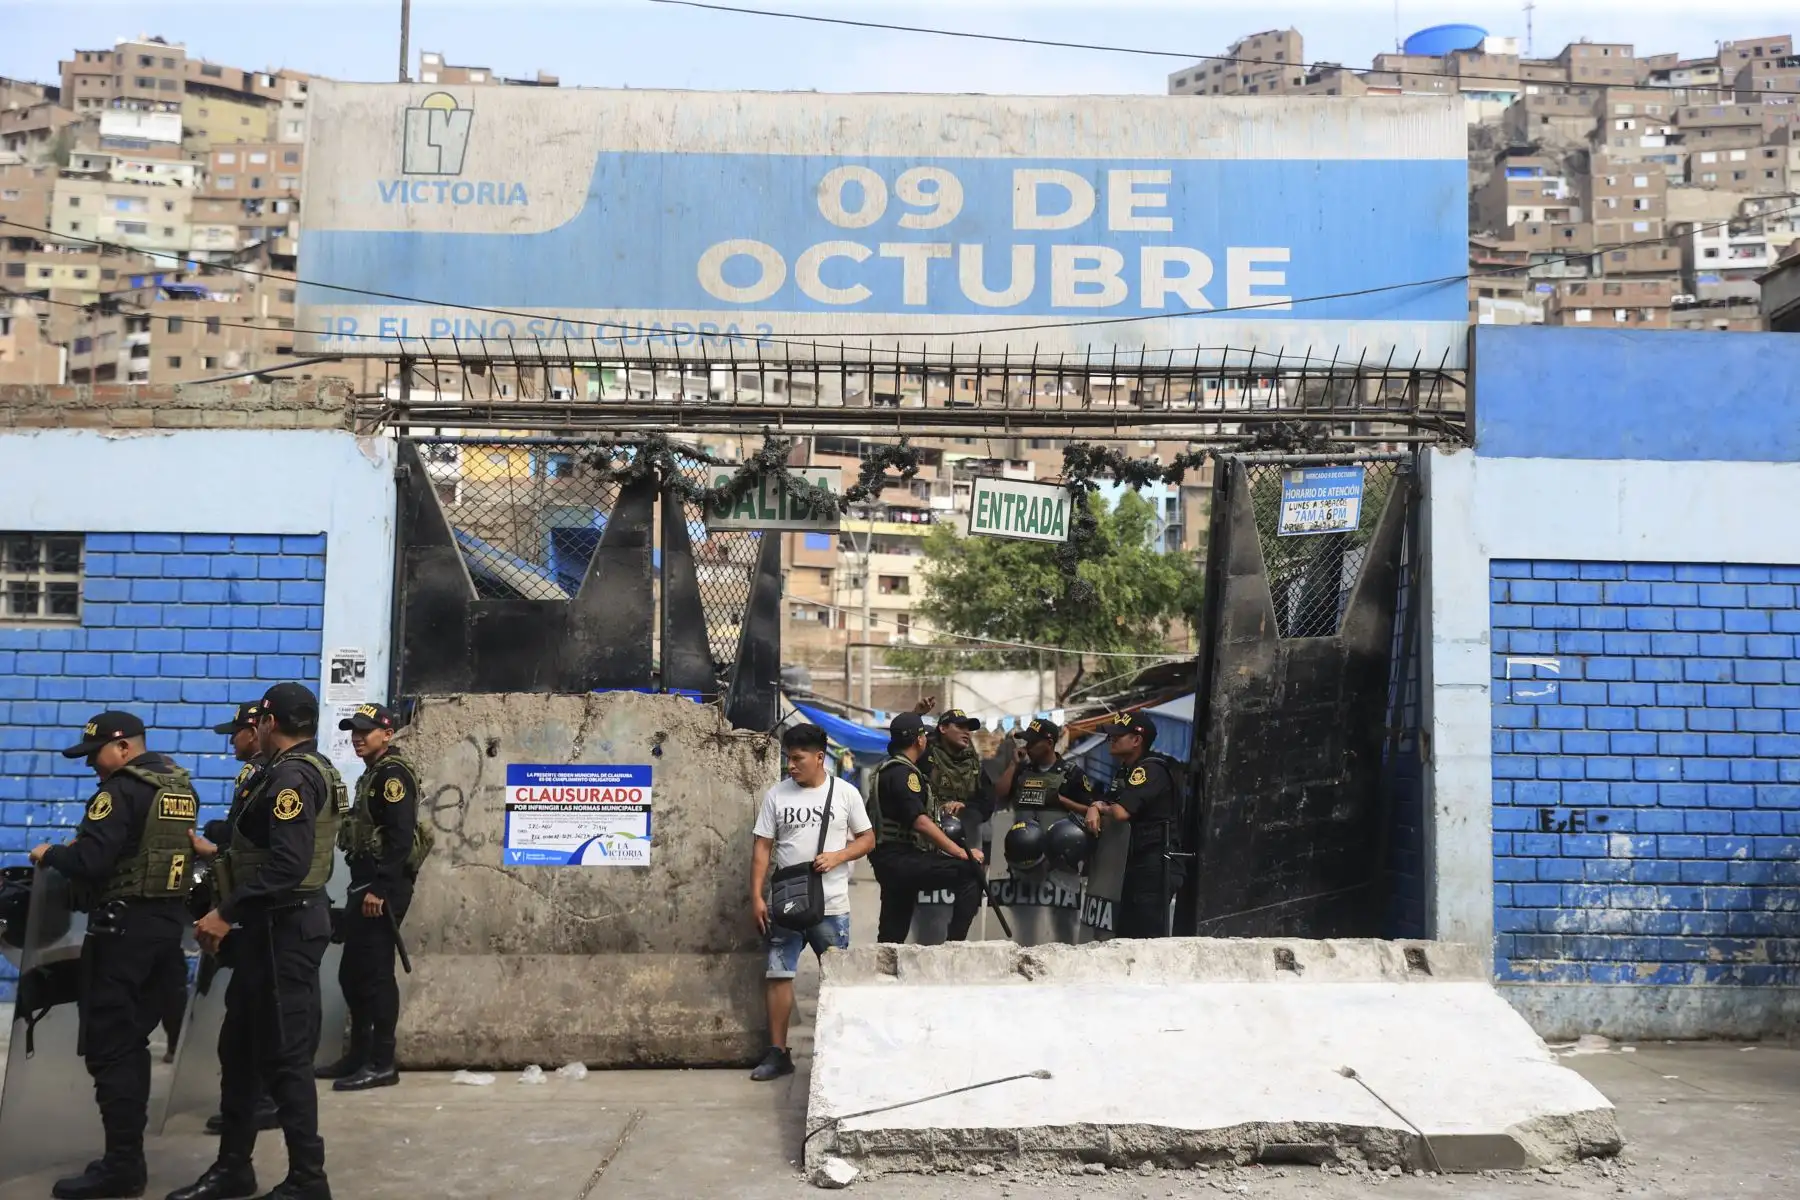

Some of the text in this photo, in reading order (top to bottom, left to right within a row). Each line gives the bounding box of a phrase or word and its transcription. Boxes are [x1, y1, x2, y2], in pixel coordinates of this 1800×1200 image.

[377, 179, 529, 206] VICTORIA
[817, 165, 1174, 232] 09 DE
[697, 239, 1292, 311] OCTUBRE
[317, 316, 774, 348] JR. EL PINO S/N CUADRA 2
[1285, 484, 1360, 499] HORARIO DE ATENCIÓN
[976, 490, 1064, 537] ENTRADA
[1288, 501, 1310, 511] LUNES
[516, 787, 642, 803] CLAUSURADO
[617, 842, 629, 850] LA
